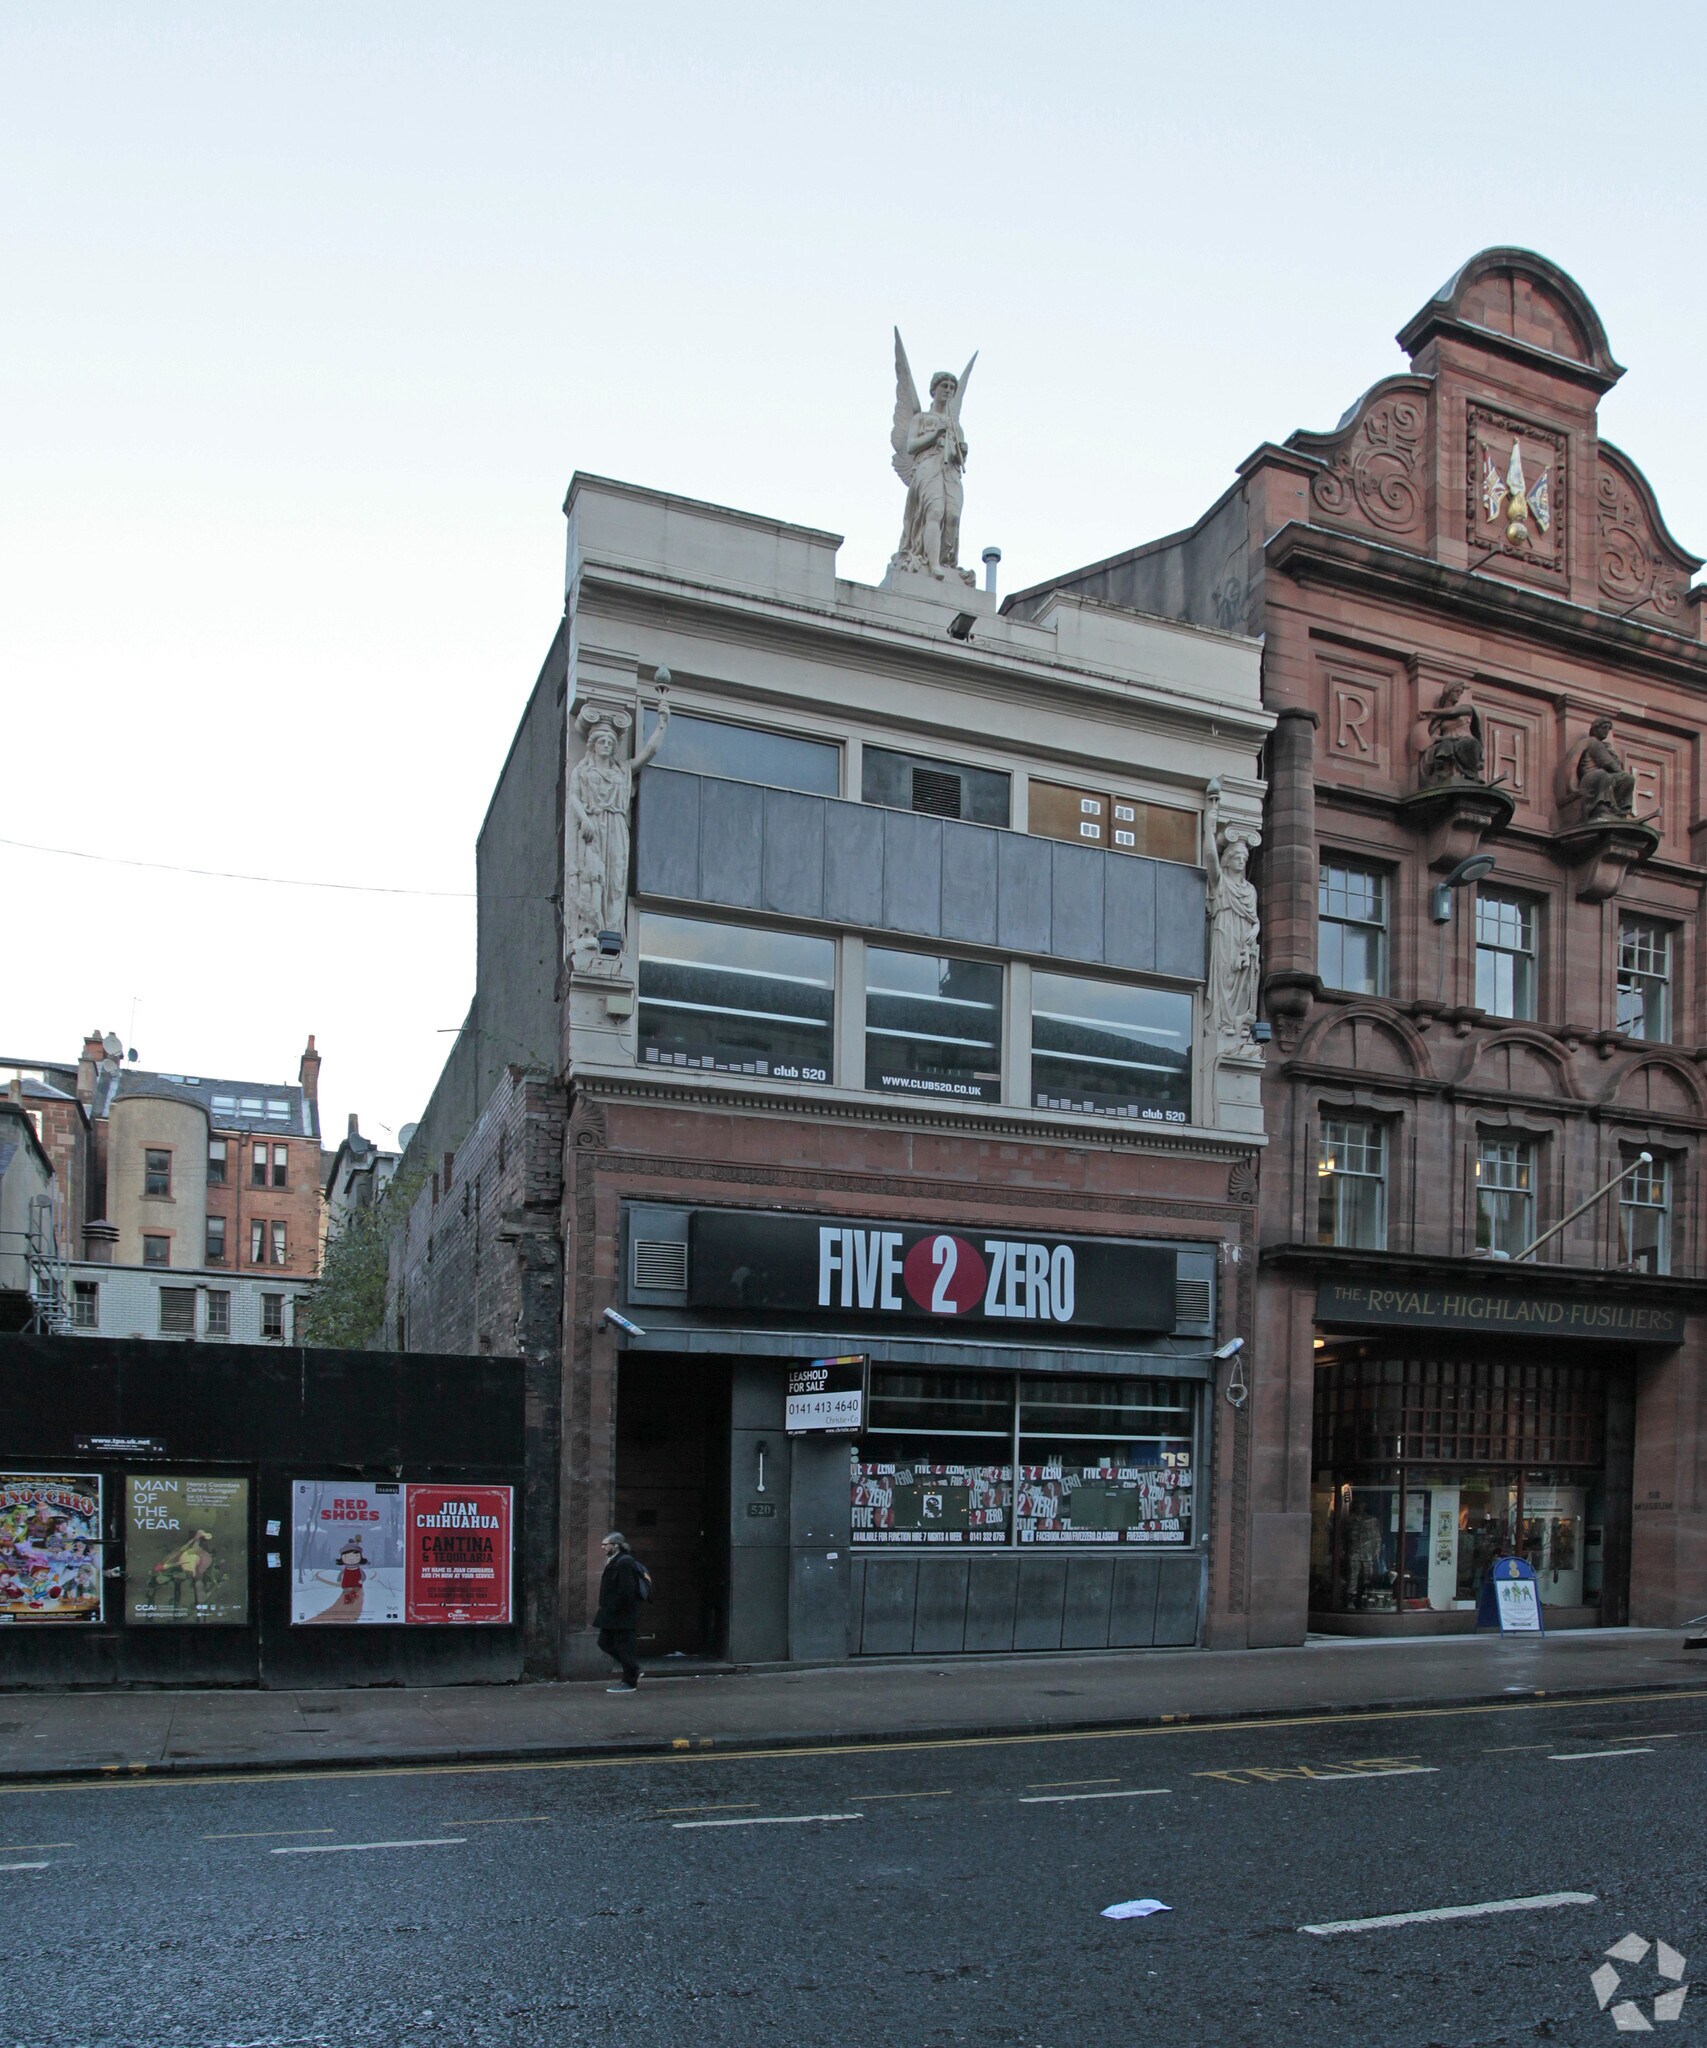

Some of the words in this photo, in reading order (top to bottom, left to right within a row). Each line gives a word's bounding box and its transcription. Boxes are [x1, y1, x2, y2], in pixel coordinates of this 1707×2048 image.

[1336, 690, 1369, 752] R
[1492, 729, 1522, 789] H
[1630, 766, 1657, 818] F
[774, 1065, 799, 1078] club
[802, 1068, 826, 1081] 520
[881, 1075, 982, 1096] WWW.CLUB520.CO.UK
[1142, 1109, 1163, 1121] club
[1165, 1110, 1186, 1122] 520
[818, 1226, 903, 1311] FIVE
[931, 1234, 958, 1314] 2
[984, 1240, 1075, 1322] ZERO
[1334, 1286, 1361, 1301] THE
[1443, 1295, 1564, 1324] HIGHLAND
[1570, 1304, 1675, 1331] FUSILIERS
[789, 1369, 828, 1382] LEASHOLD
[789, 1383, 805, 1393] FOR
[806, 1381, 825, 1392] SALE
[789, 1403, 811, 1415] 0141
[814, 1401, 832, 1413] 413
[835, 1399, 859, 1412] 4640
[134, 1480, 178, 1492] MAN
[134, 1492, 158, 1504] OF
[333, 1498, 368, 1510] RED
[133, 1505, 168, 1517] THE
[439, 1502, 478, 1516] JUAN
[751, 1505, 771, 1515] 520
[1634, 1502, 1673, 1511] MUSEUM
[321, 1509, 380, 1521] SHOES
[416, 1514, 500, 1529] CHIHUAHUA
[851, 1507, 875, 1528] FIVE
[880, 1507, 889, 1529] 2
[985, 1508, 1004, 1524] ZERO
[134, 1518, 180, 1530] YEAR
[422, 1536, 493, 1553] CANTINA
